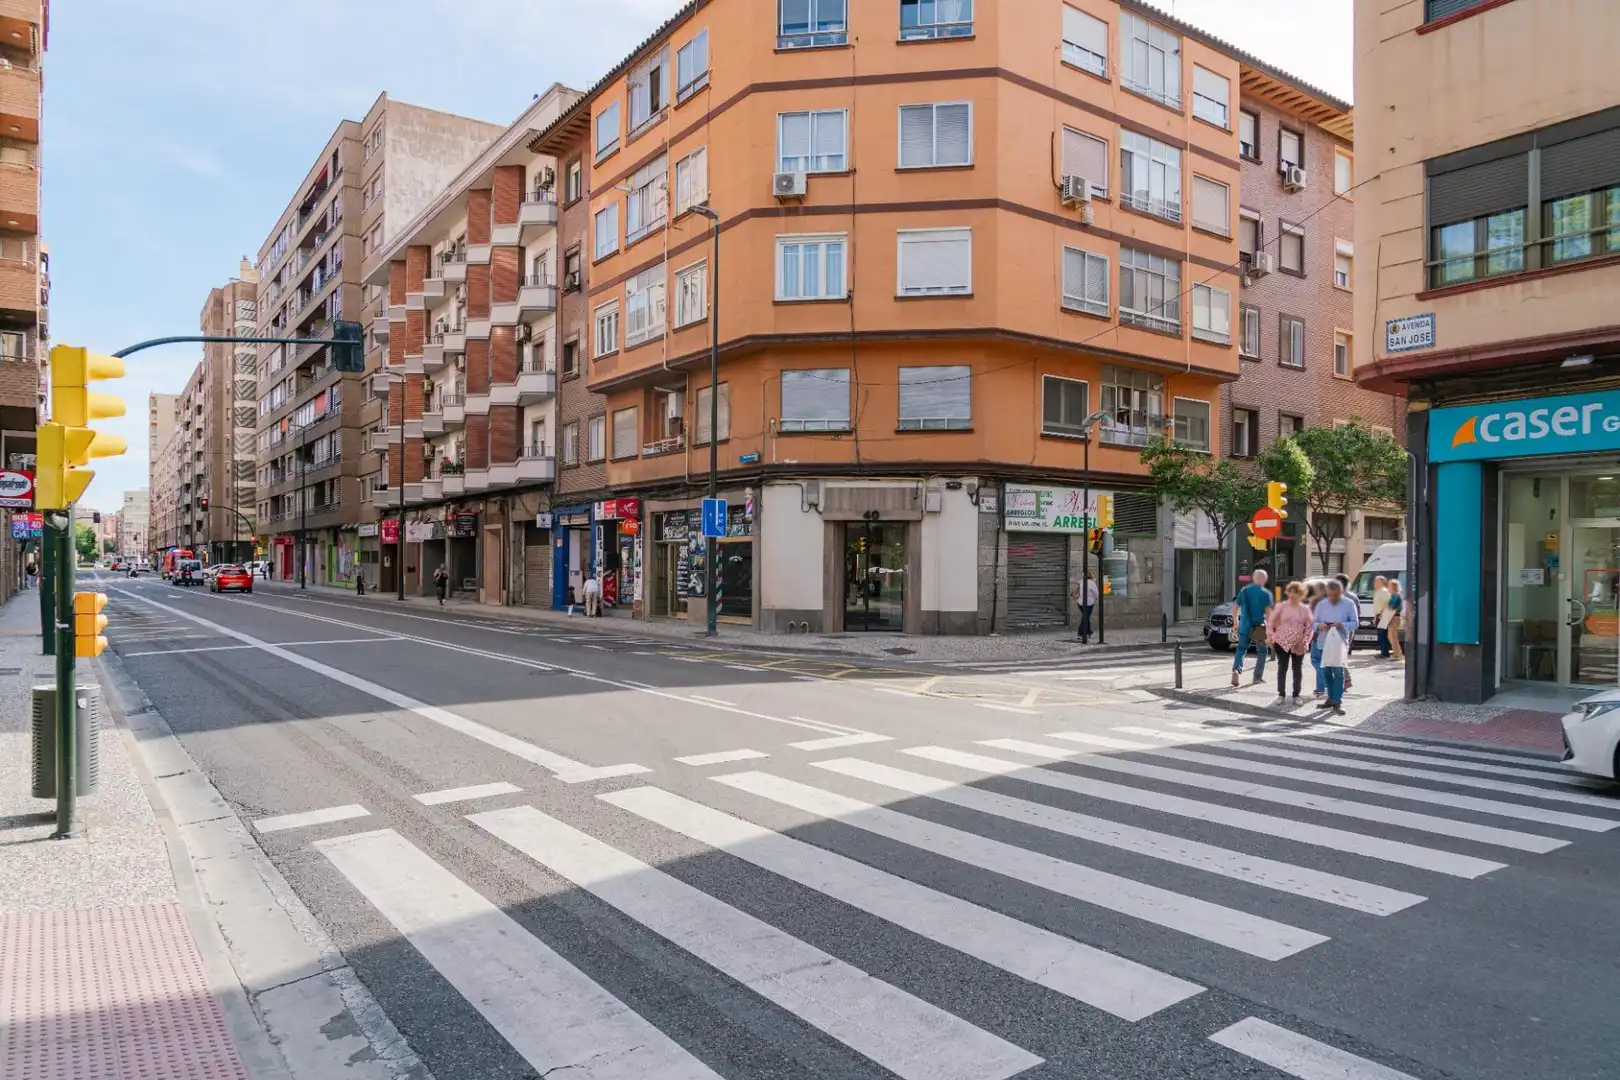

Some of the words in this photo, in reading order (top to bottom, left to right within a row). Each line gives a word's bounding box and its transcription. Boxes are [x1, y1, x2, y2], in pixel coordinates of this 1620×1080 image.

[1402, 320, 1430, 330] AVENIDA
[1390, 336, 1406, 347] SAN
[1409, 332, 1430, 344] JOSE
[1480, 403, 1603, 443] caser
[31, 521, 41, 529] 40
